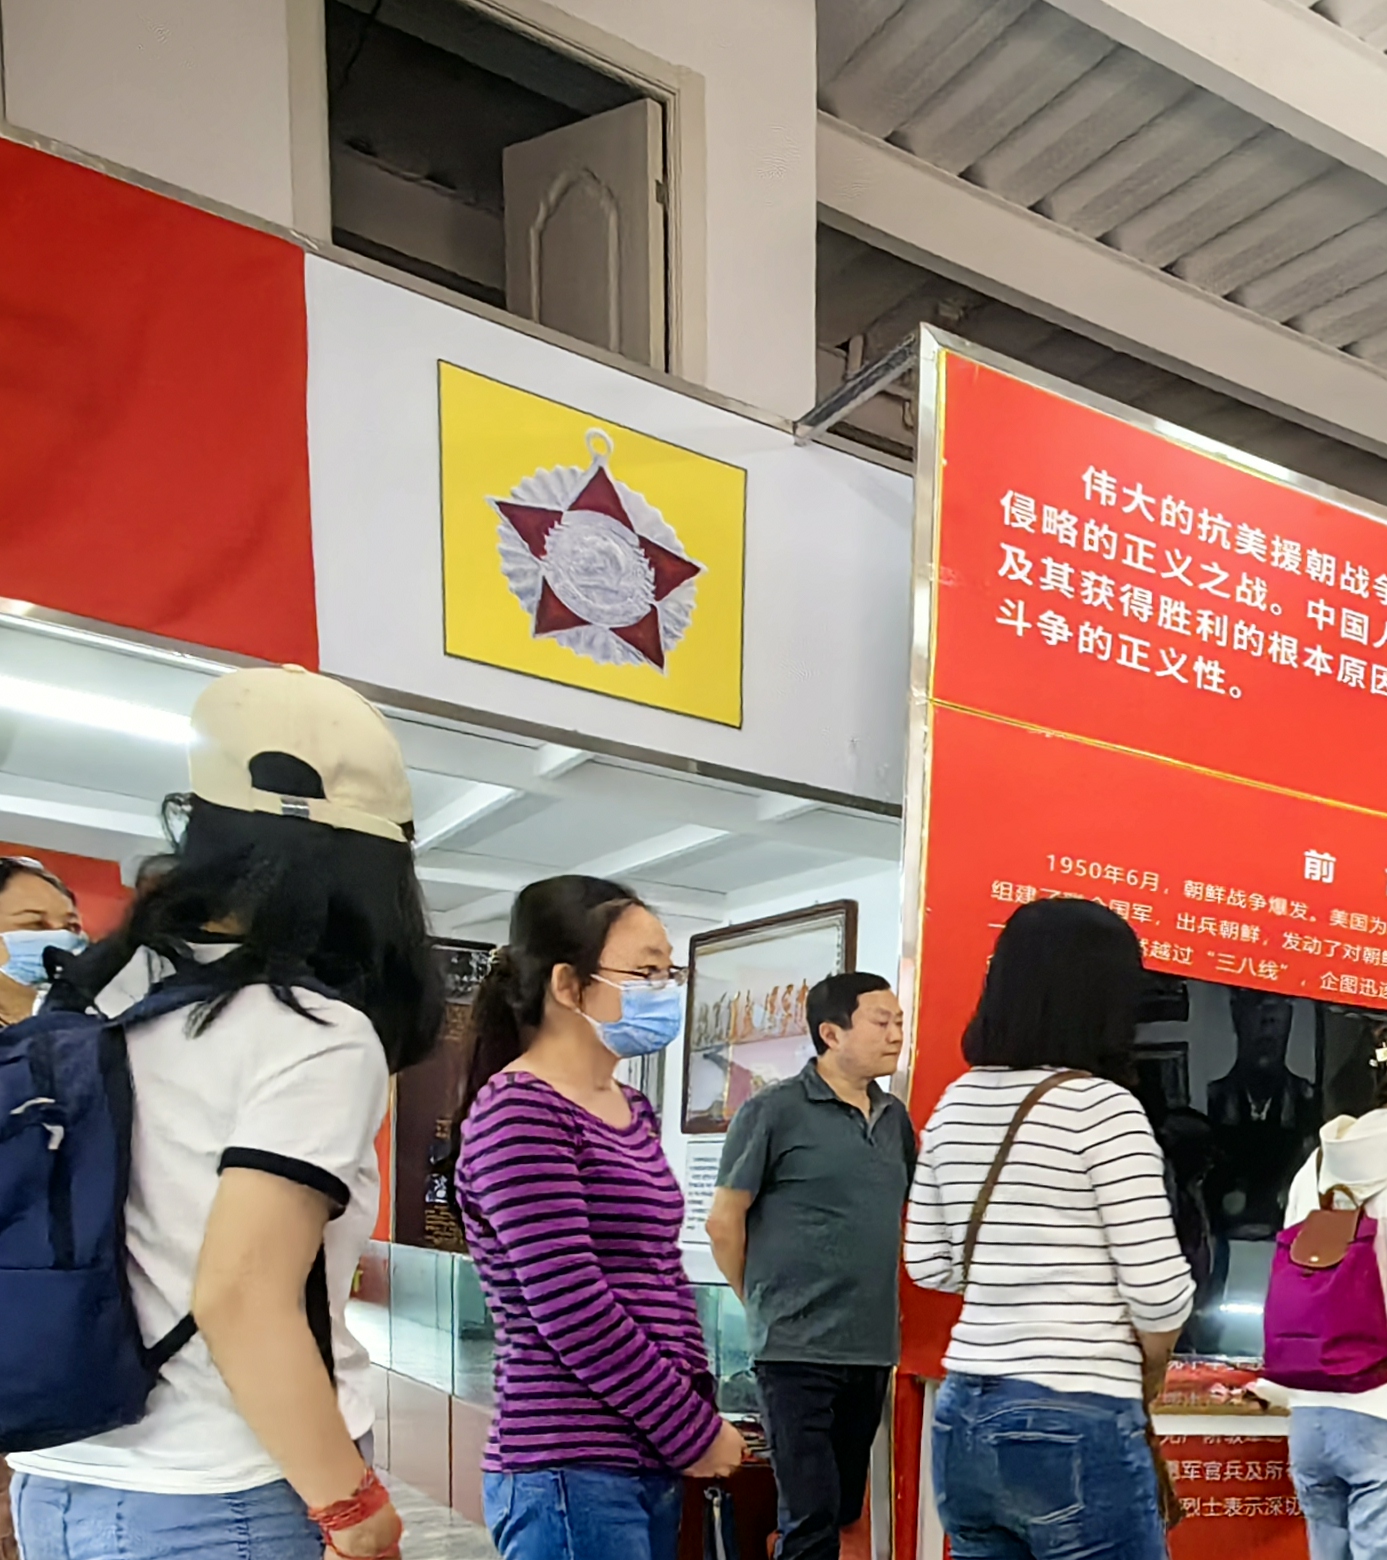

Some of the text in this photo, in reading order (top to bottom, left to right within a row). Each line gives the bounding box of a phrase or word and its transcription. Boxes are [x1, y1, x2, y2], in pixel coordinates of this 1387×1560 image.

[995, 598, 1242, 699] 斗争的正义性。
